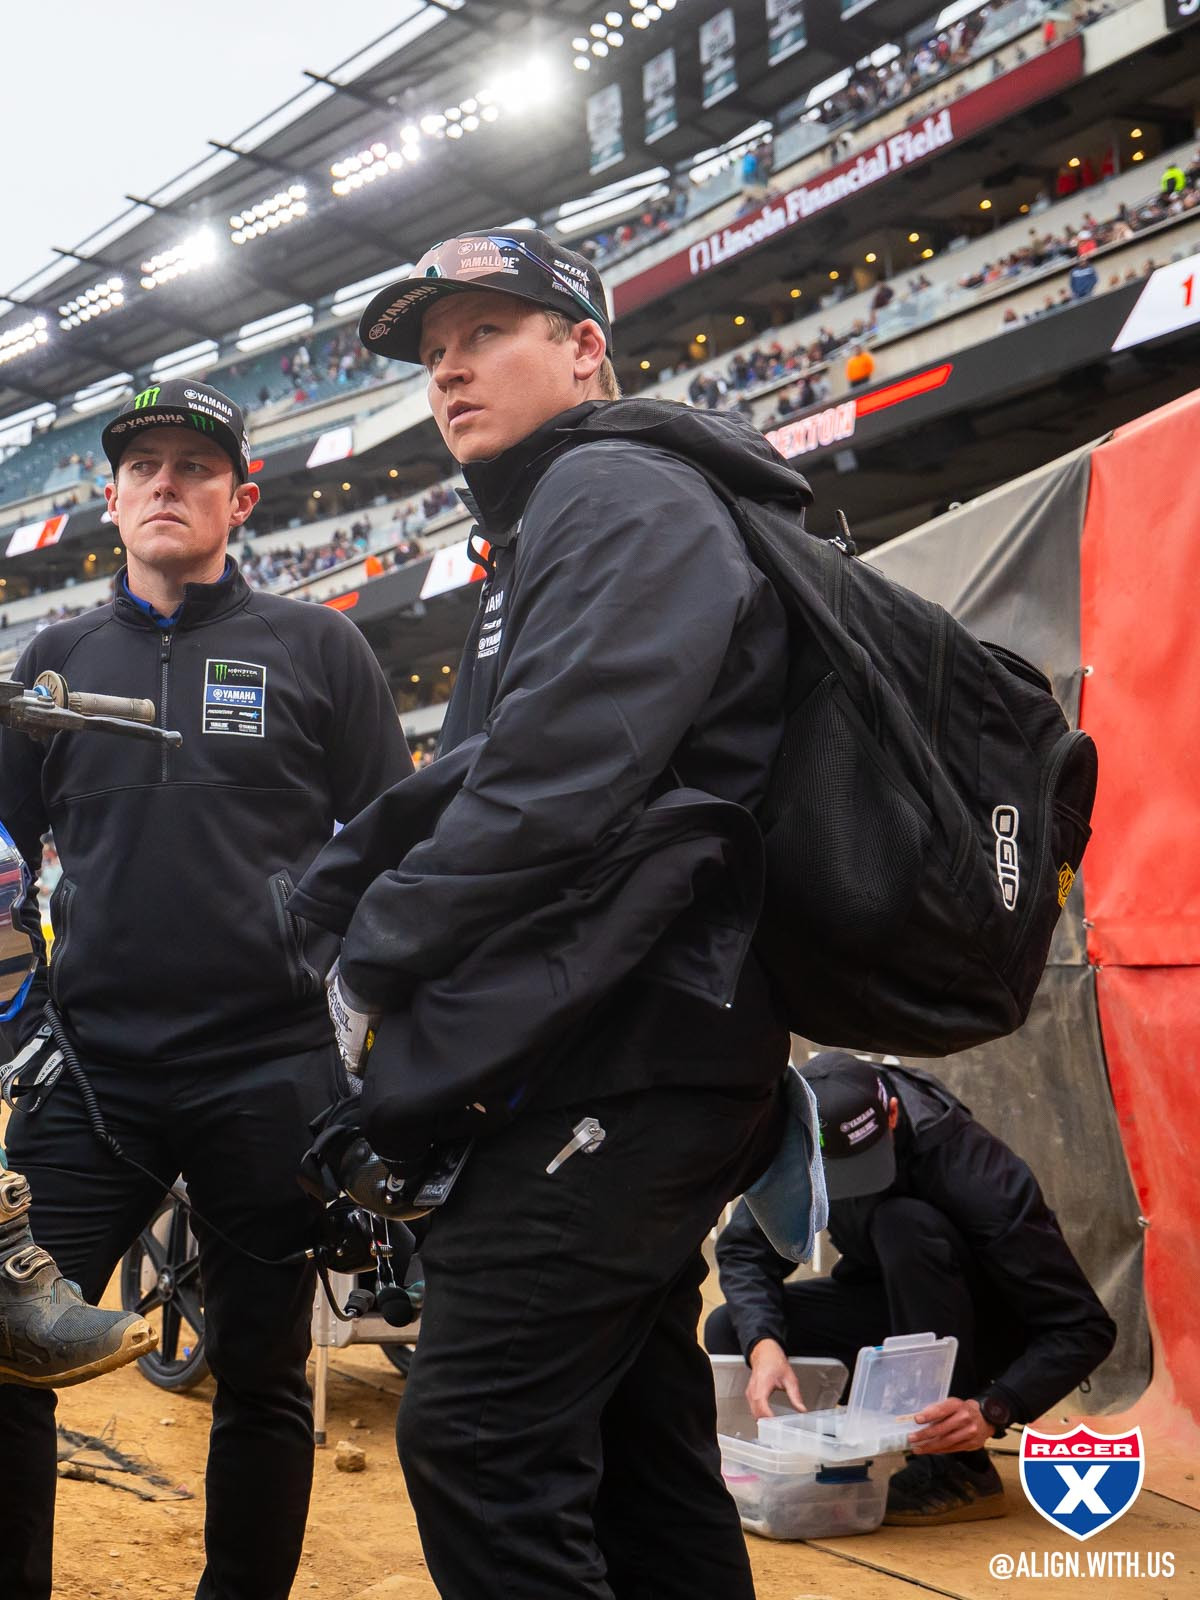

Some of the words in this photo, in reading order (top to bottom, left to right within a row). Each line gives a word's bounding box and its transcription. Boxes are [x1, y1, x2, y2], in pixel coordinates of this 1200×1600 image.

[710, 204, 788, 266] Lincoln
[784, 145, 890, 224] Financial
[885, 108, 954, 171] Field
[1179, 273, 1194, 307] 1
[377, 285, 438, 322] YAMAHA
[196, 392, 233, 417] YAMAHA
[127, 414, 185, 427] YAMAHA
[227, 667, 258, 676] MONSTER
[223, 689, 257, 701] YAMAHA
[992, 805, 1019, 912] OGIO
[422, 1184, 447, 1195] TRACK
